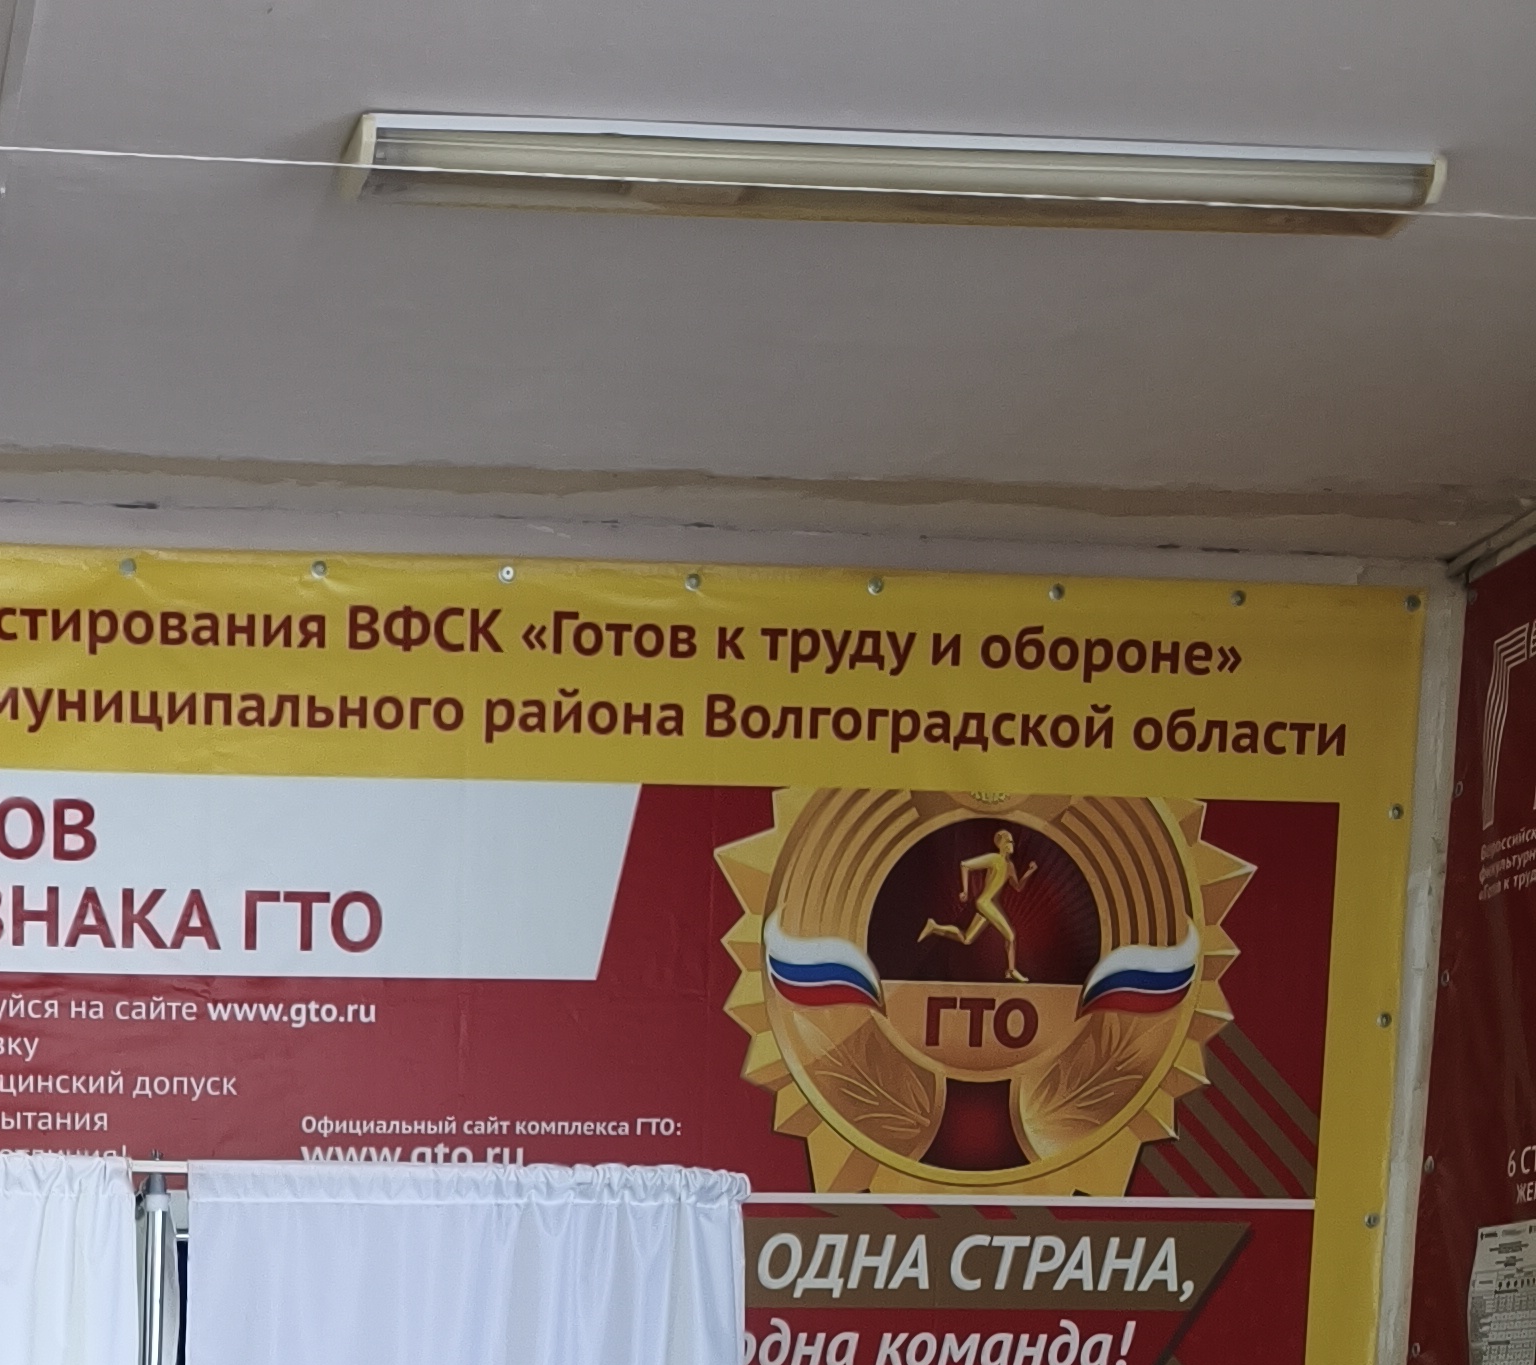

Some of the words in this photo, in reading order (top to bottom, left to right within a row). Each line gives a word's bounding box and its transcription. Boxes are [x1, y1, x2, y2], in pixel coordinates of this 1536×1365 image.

[347, 606, 504, 654] ВФСК
[523, 611, 698, 662] «Готов
[717, 626, 745, 660] к
[761, 626, 916, 673] труду
[932, 633, 962, 667] и
[980, 624, 1242, 682] обороне»
[483, 690, 685, 741] района
[706, 694, 1114, 754] Волгоградской
[1132, 710, 1348, 757] области
[244, 890, 384, 953] ГТО
[70, 1000, 104, 1019] на
[115, 997, 198, 1021] сайте
[207, 1002, 376, 1028] www.gto.ru
[923, 995, 1041, 1051] ГТО
[133, 1075, 238, 1101] допуск
[301, 1115, 457, 1139] Официальный
[463, 1117, 511, 1136] сайт
[515, 1119, 630, 1137] комплекса
[636, 1118, 682, 1137] ГТО:
[300, 1142, 525, 1165] wwwgtoru
[1516, 1182, 1536, 1204] ЖЕ
[757, 1233, 930, 1299] ОДНА
[950, 1235, 1196, 1302] СТРАНА,
